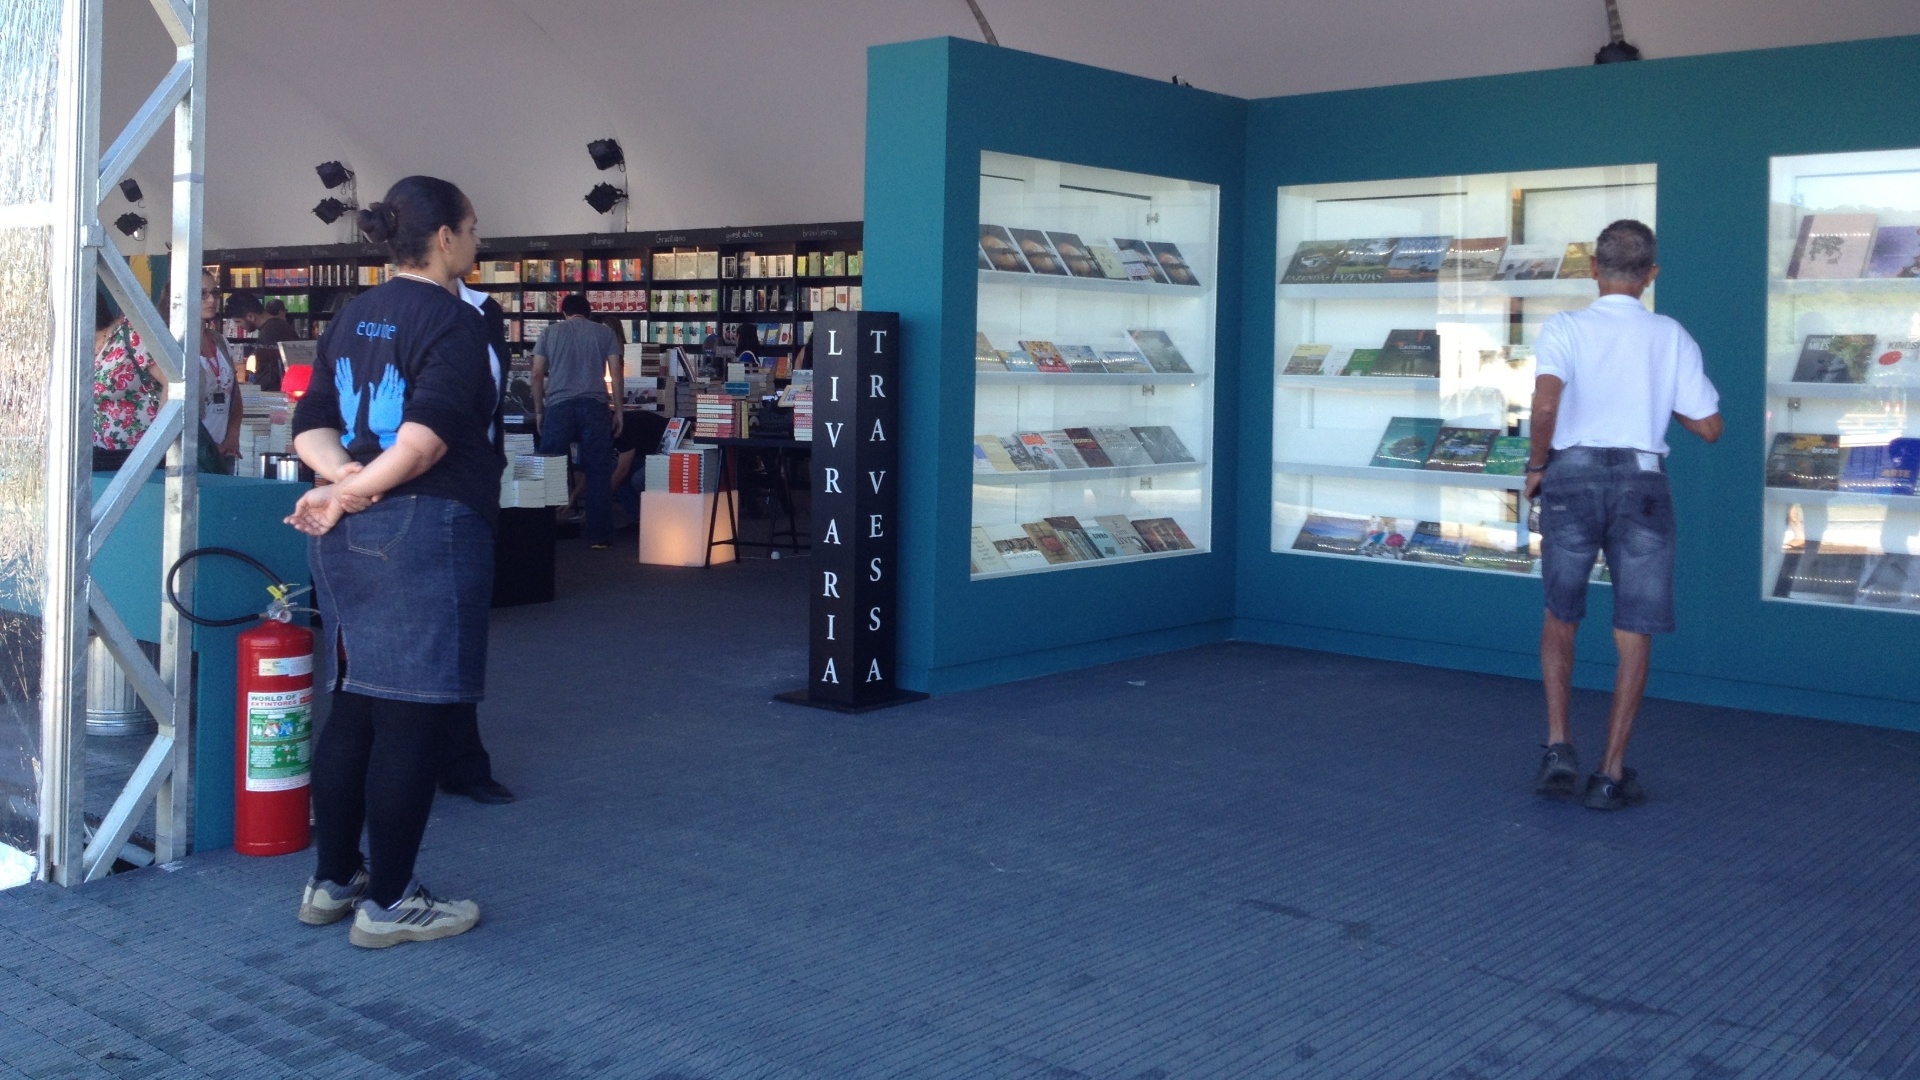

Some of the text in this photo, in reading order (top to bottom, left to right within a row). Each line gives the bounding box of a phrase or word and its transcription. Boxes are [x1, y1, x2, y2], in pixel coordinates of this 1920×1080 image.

[356, 318, 396, 342] equie
[865, 329, 887, 683] TRAVESSA
[821, 330, 843, 685] LIVRARIA
